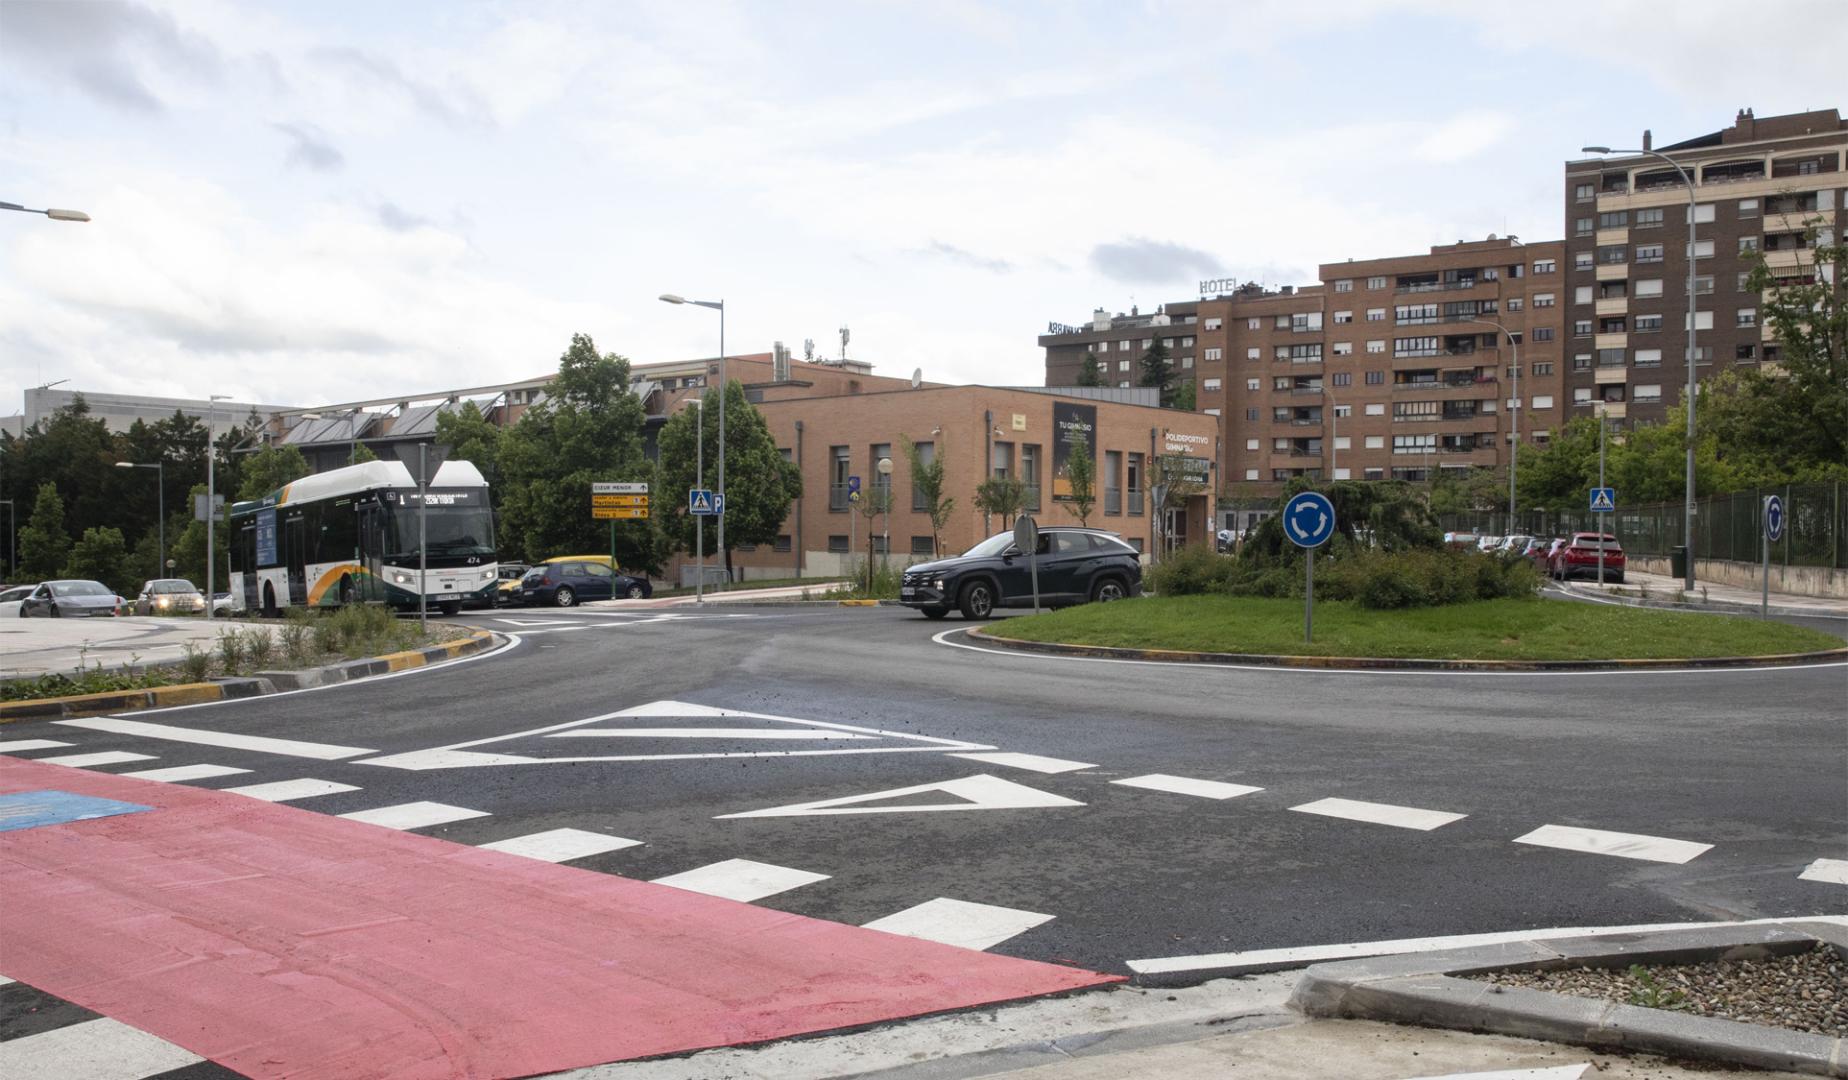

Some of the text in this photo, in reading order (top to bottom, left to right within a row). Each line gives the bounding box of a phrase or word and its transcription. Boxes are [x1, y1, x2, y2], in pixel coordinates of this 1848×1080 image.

[1200, 277, 1237, 293] HOTEL
[1060, 421, 1067, 429] TU
[1165, 433, 1208, 444] POLIDEPORTIVO
[400, 494, 405, 505] 1
[715, 497, 721, 512] P
